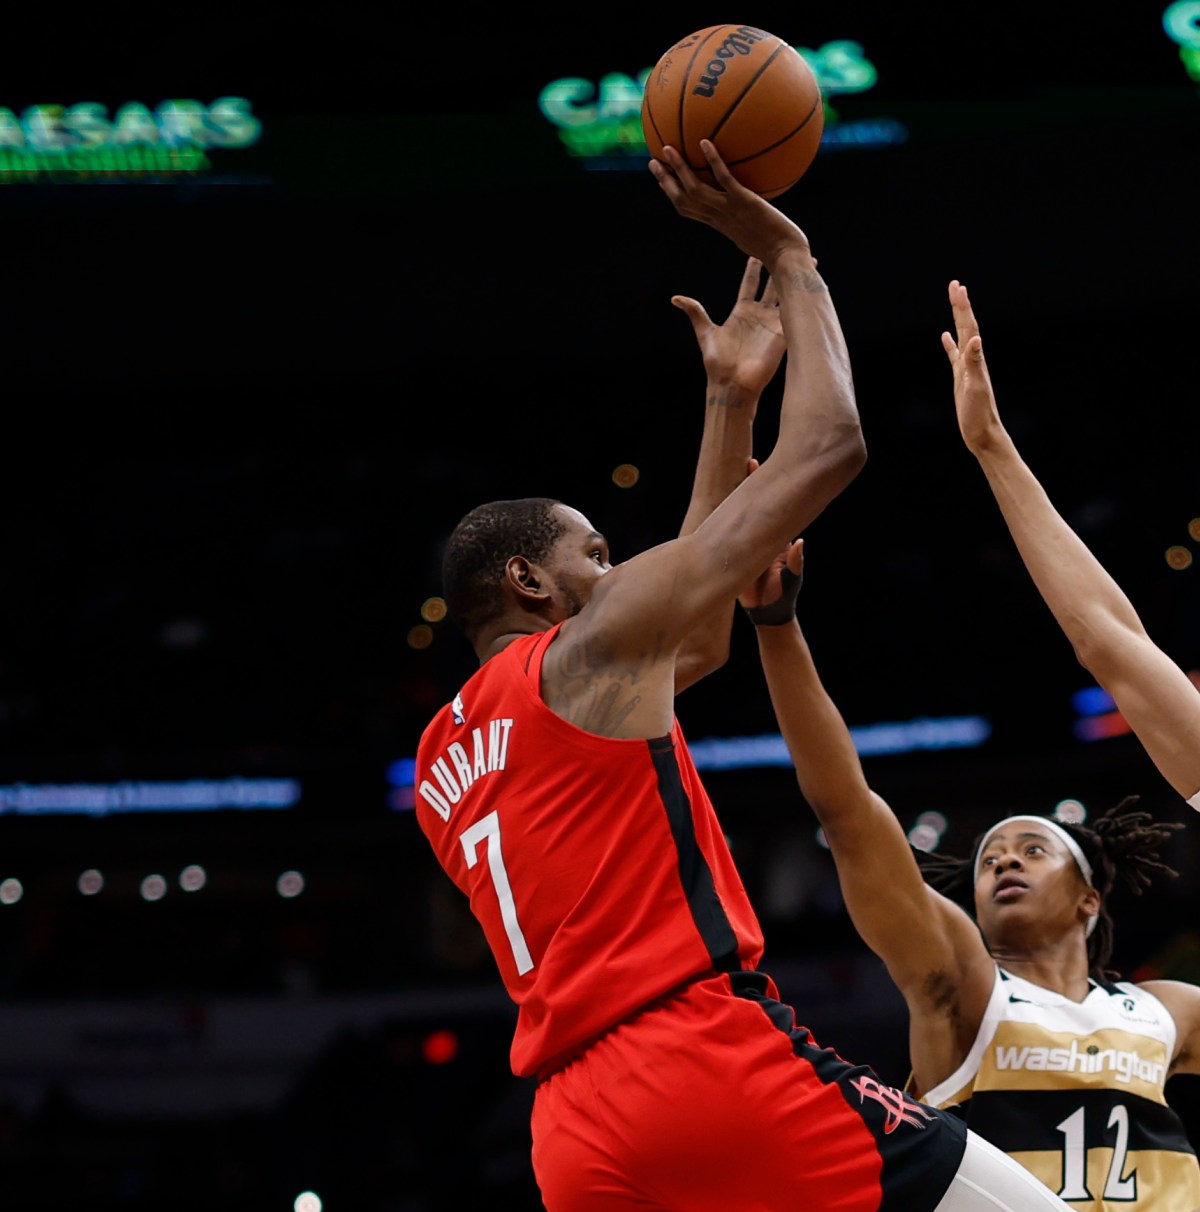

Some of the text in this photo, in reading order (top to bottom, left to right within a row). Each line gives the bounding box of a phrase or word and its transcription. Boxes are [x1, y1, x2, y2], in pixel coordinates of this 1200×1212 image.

[418, 718, 514, 823] DURANT
[459, 809, 535, 977] 7
[995, 1039, 1166, 1084] washington
[1055, 1104, 1138, 1203] 12
